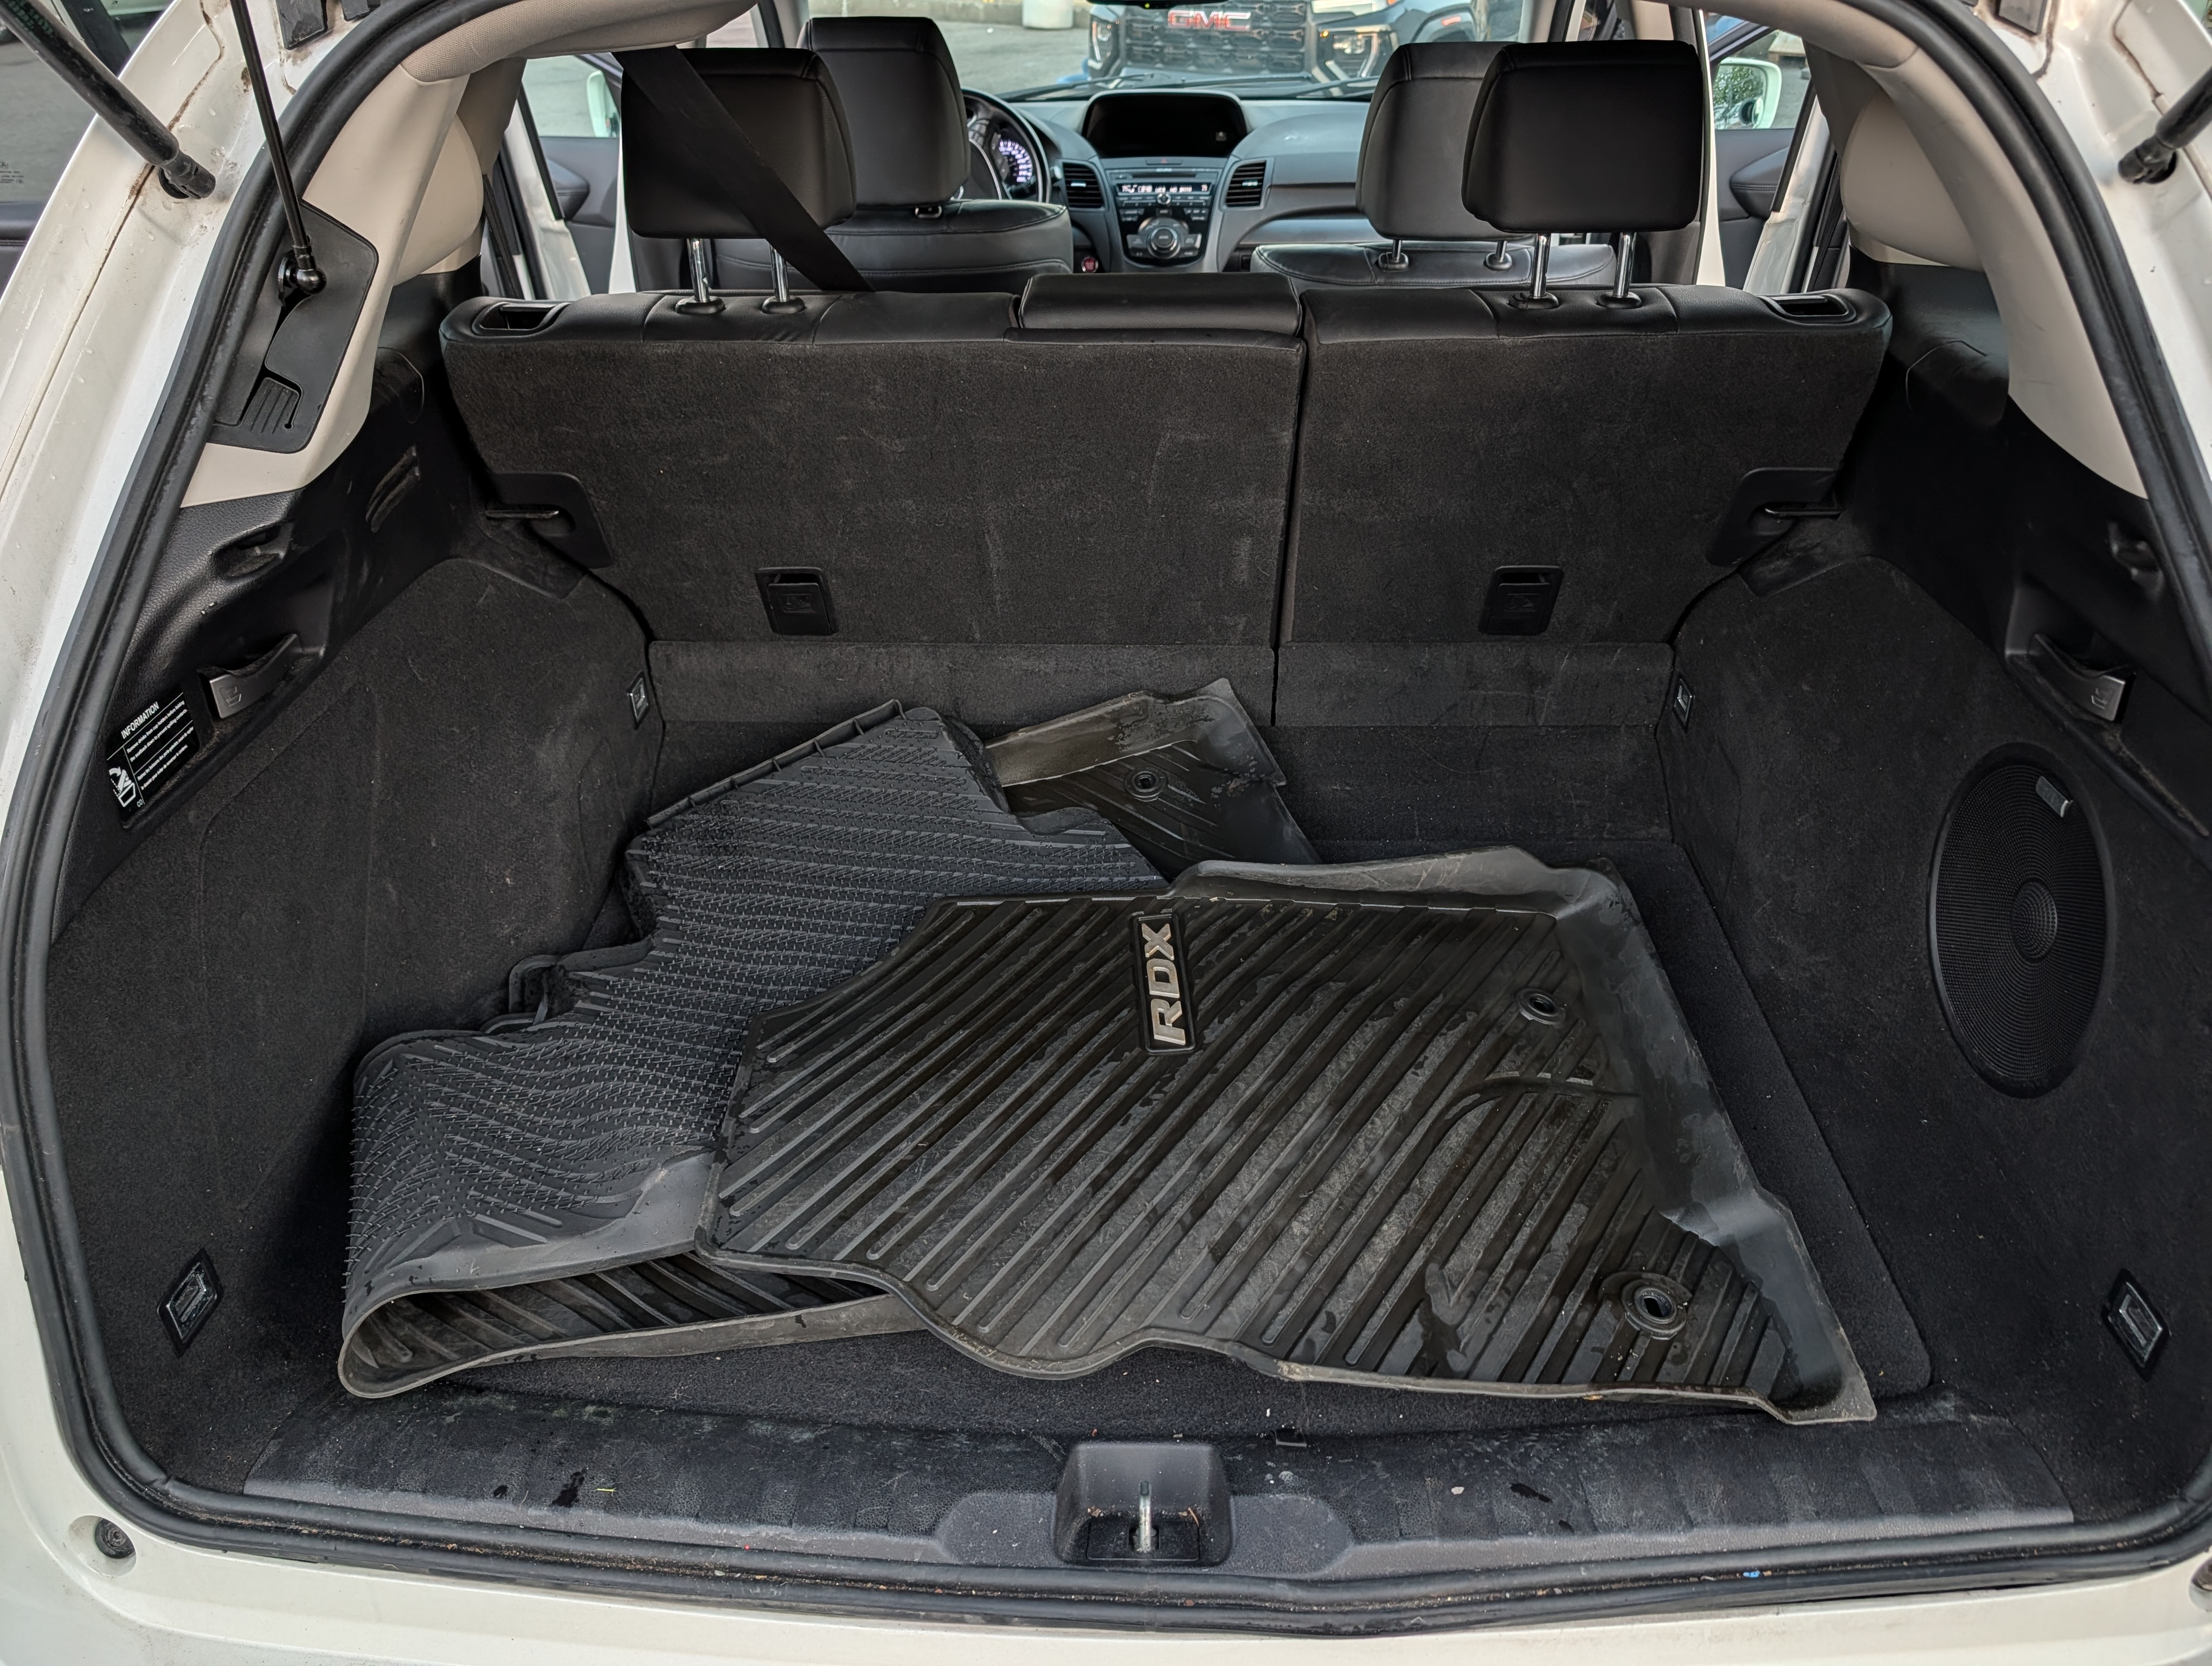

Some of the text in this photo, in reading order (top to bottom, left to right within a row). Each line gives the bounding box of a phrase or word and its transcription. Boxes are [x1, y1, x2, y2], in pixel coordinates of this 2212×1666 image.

[1168, 10, 1251, 31] GMC
[121, 701, 159, 739] INFORMATION
[1141, 922, 1186, 1046] RDX
